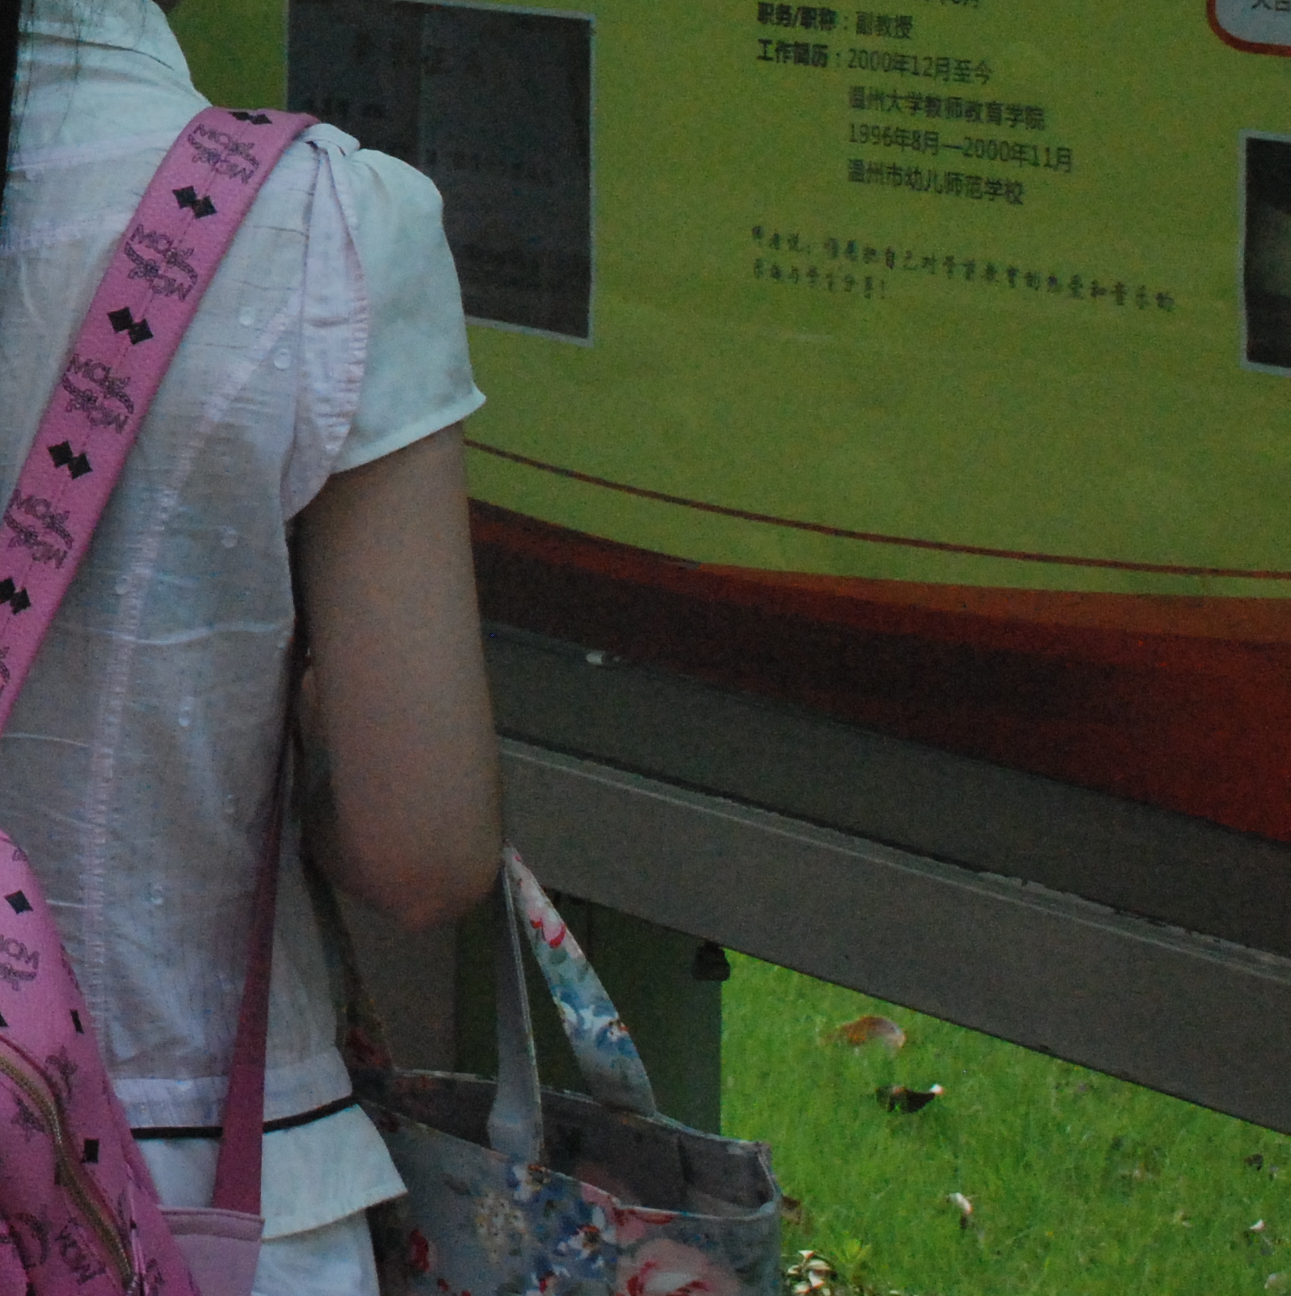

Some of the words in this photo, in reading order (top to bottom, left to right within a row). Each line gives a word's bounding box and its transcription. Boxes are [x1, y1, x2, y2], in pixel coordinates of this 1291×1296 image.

[848, 85, 1045, 130] 温州大学教师教育学院
[847, 158, 1024, 205] 温州市幼儿师范学校
